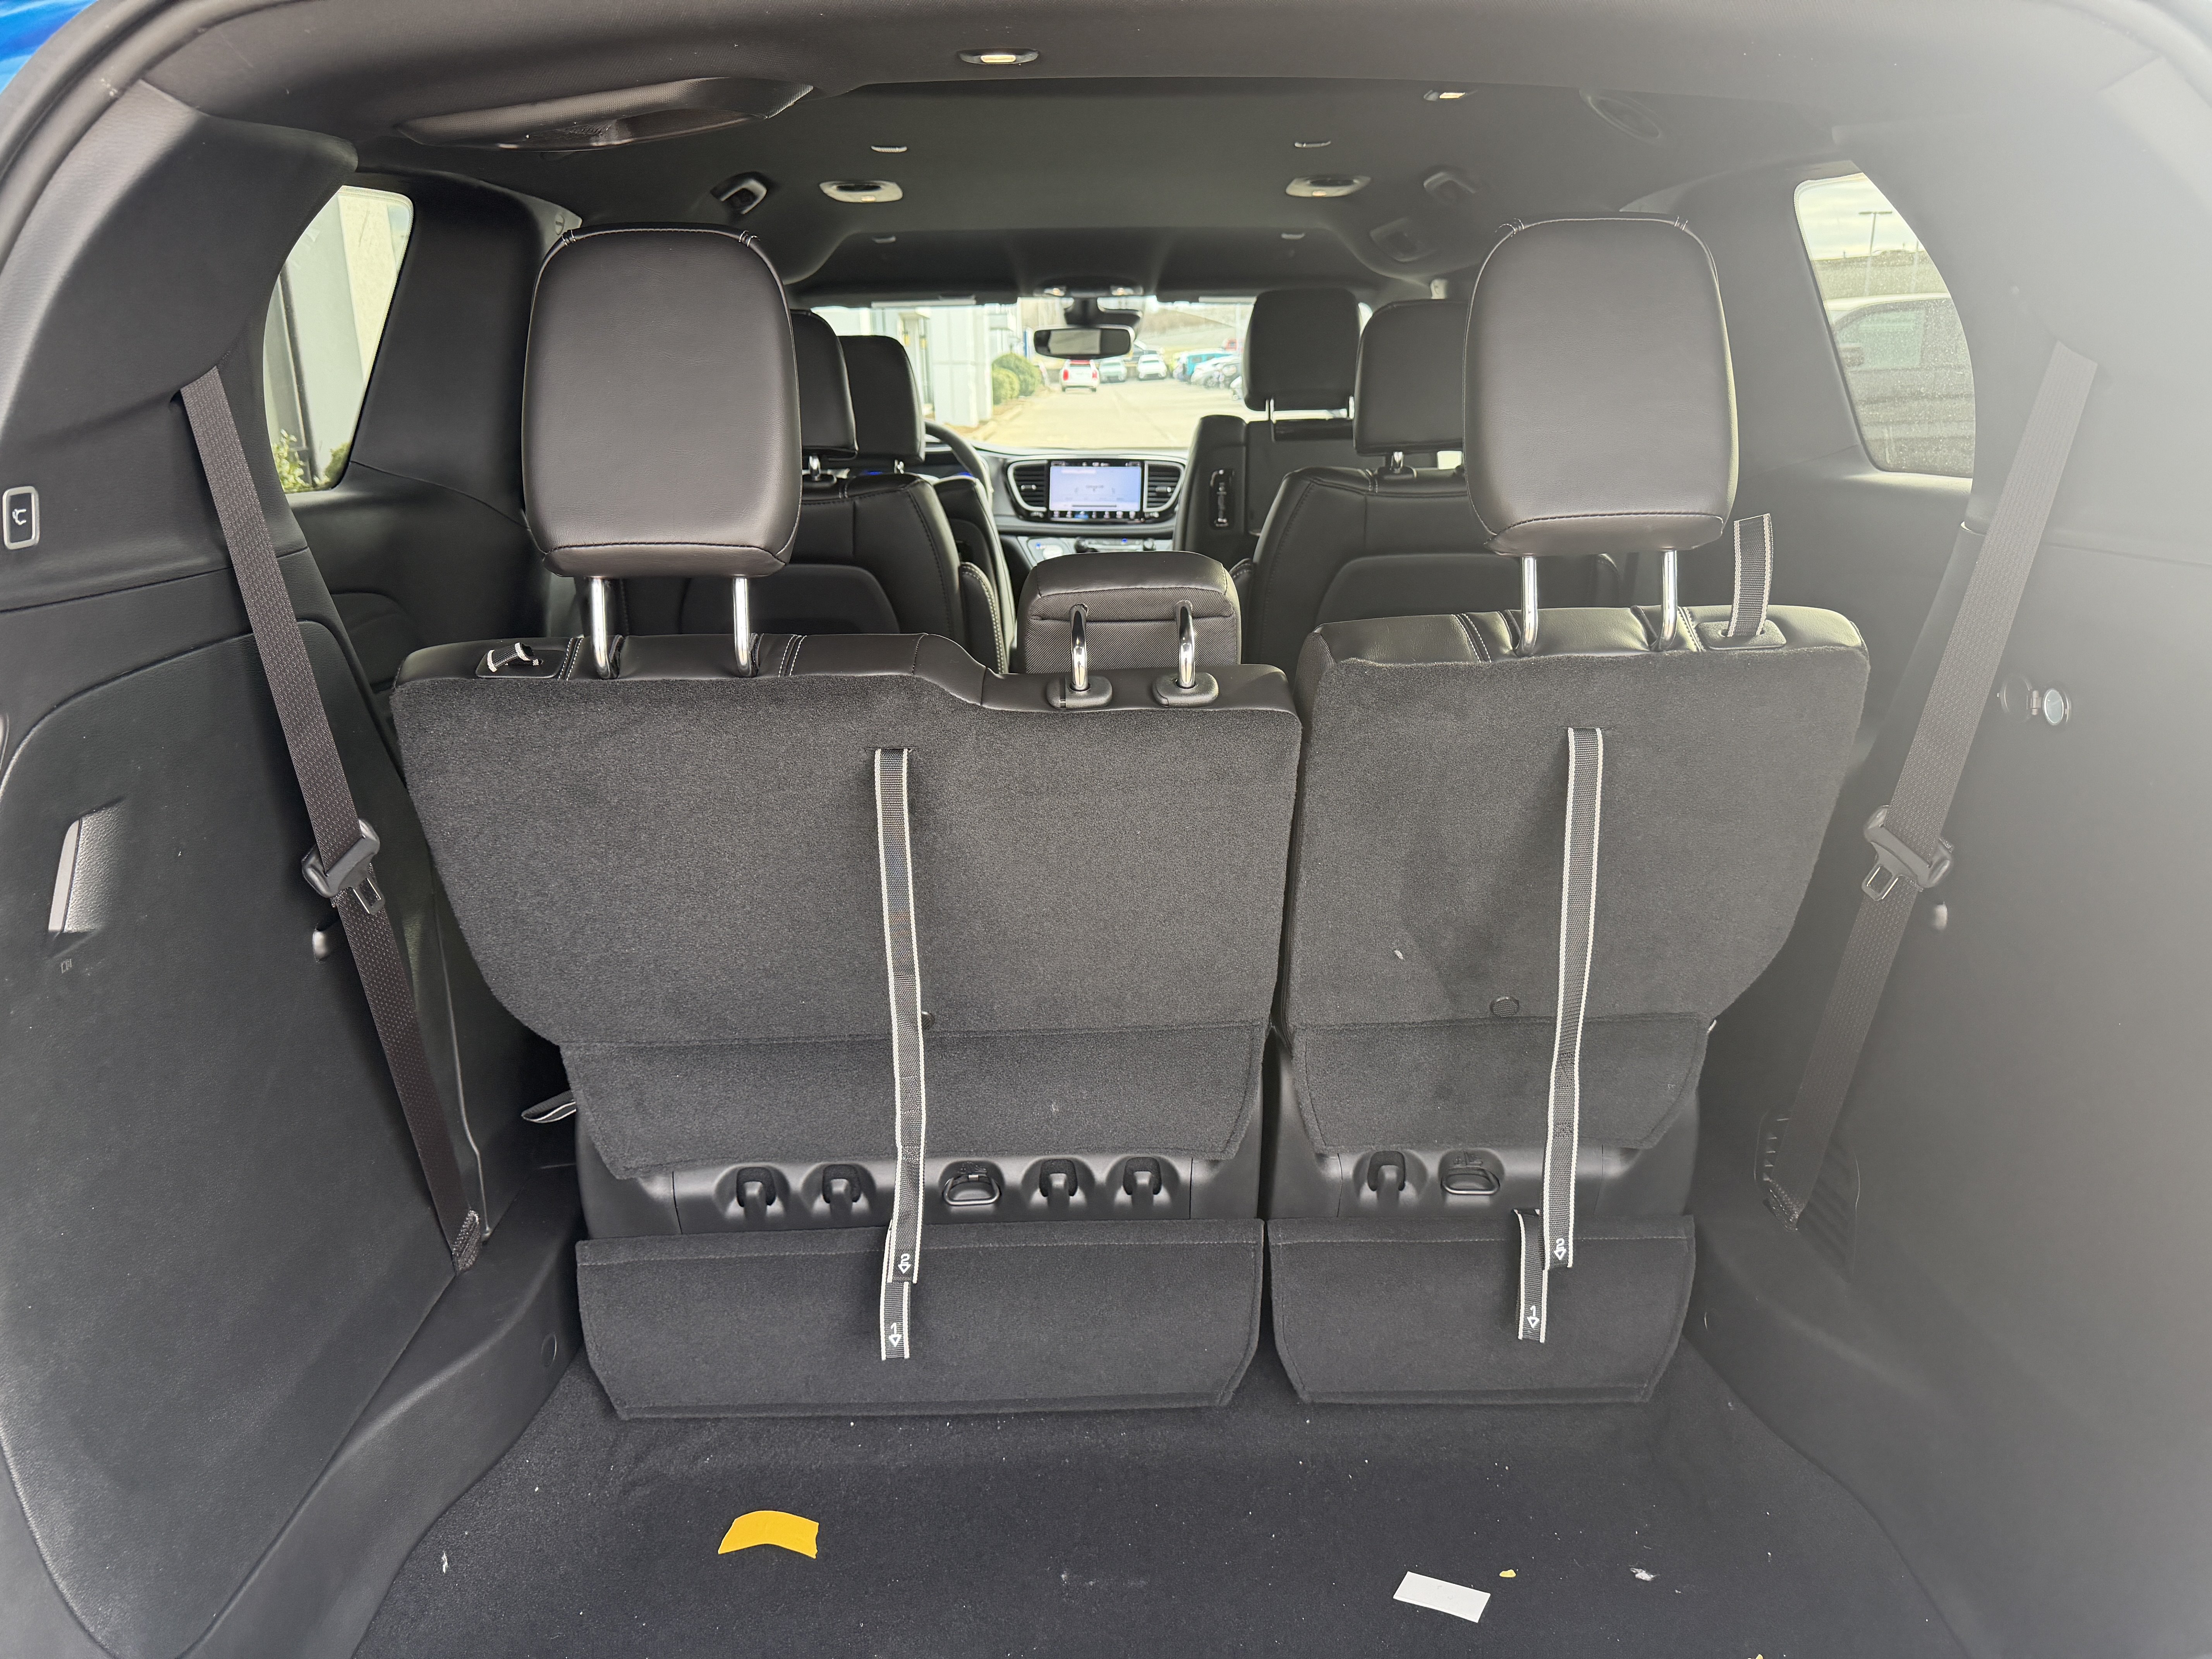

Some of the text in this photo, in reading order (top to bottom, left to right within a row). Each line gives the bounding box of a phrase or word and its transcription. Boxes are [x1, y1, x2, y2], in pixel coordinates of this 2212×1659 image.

[1556, 1238, 1565, 1249] 2
[900, 1253, 910, 1264] 2
[1530, 1305, 1536, 1317] 1
[890, 1322, 897, 1334] 1
